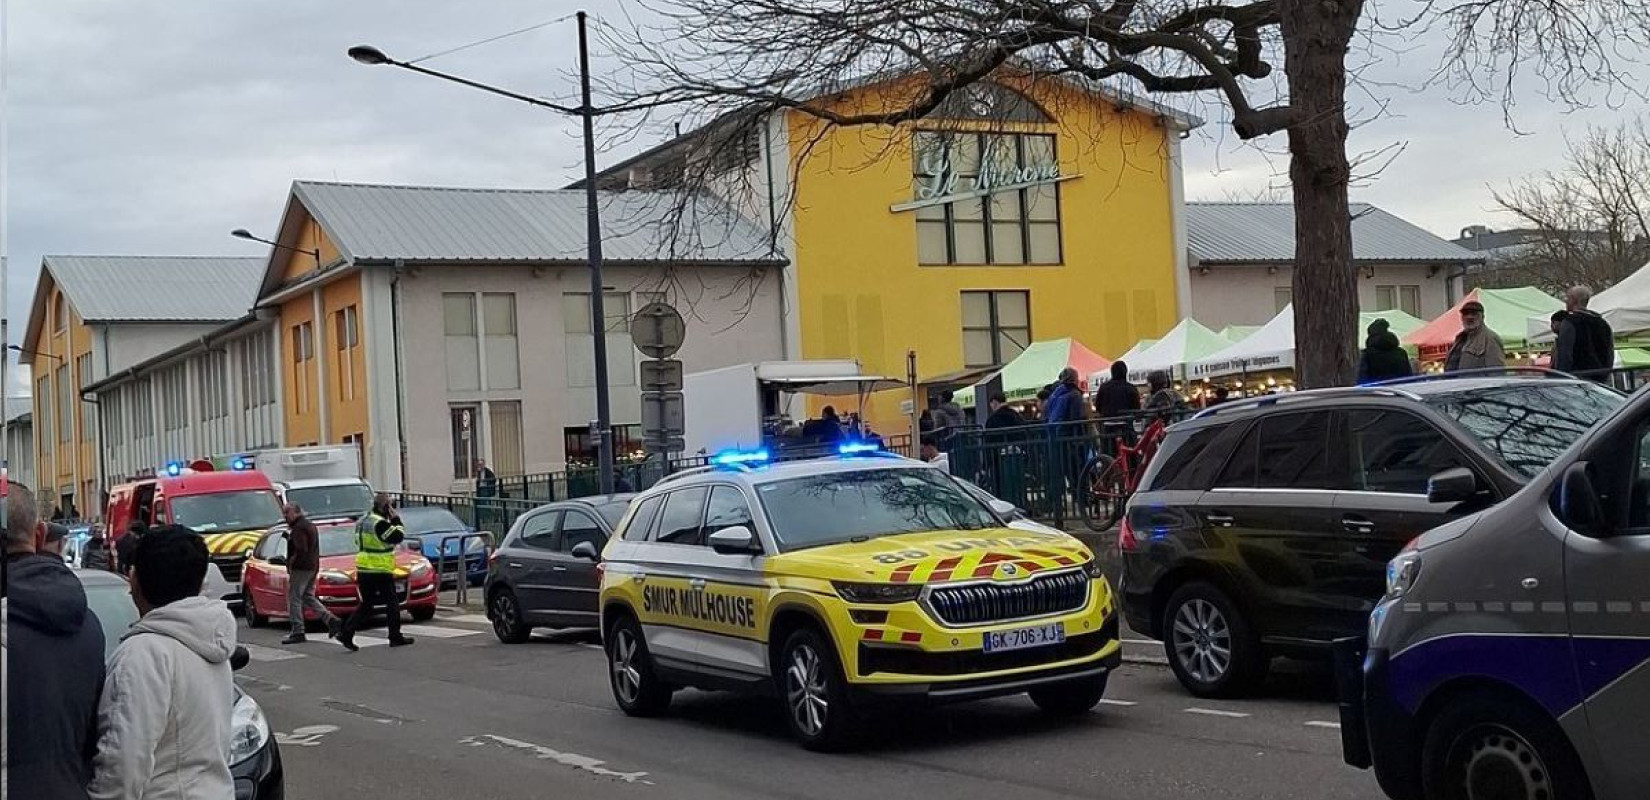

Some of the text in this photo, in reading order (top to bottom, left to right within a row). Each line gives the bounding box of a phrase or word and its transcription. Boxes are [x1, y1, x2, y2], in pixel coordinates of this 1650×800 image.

[919, 141, 959, 200] Le
[644, 585, 755, 628] SMUR MULHOUSE
[992, 624, 1056, 648] GK-706-XJ
